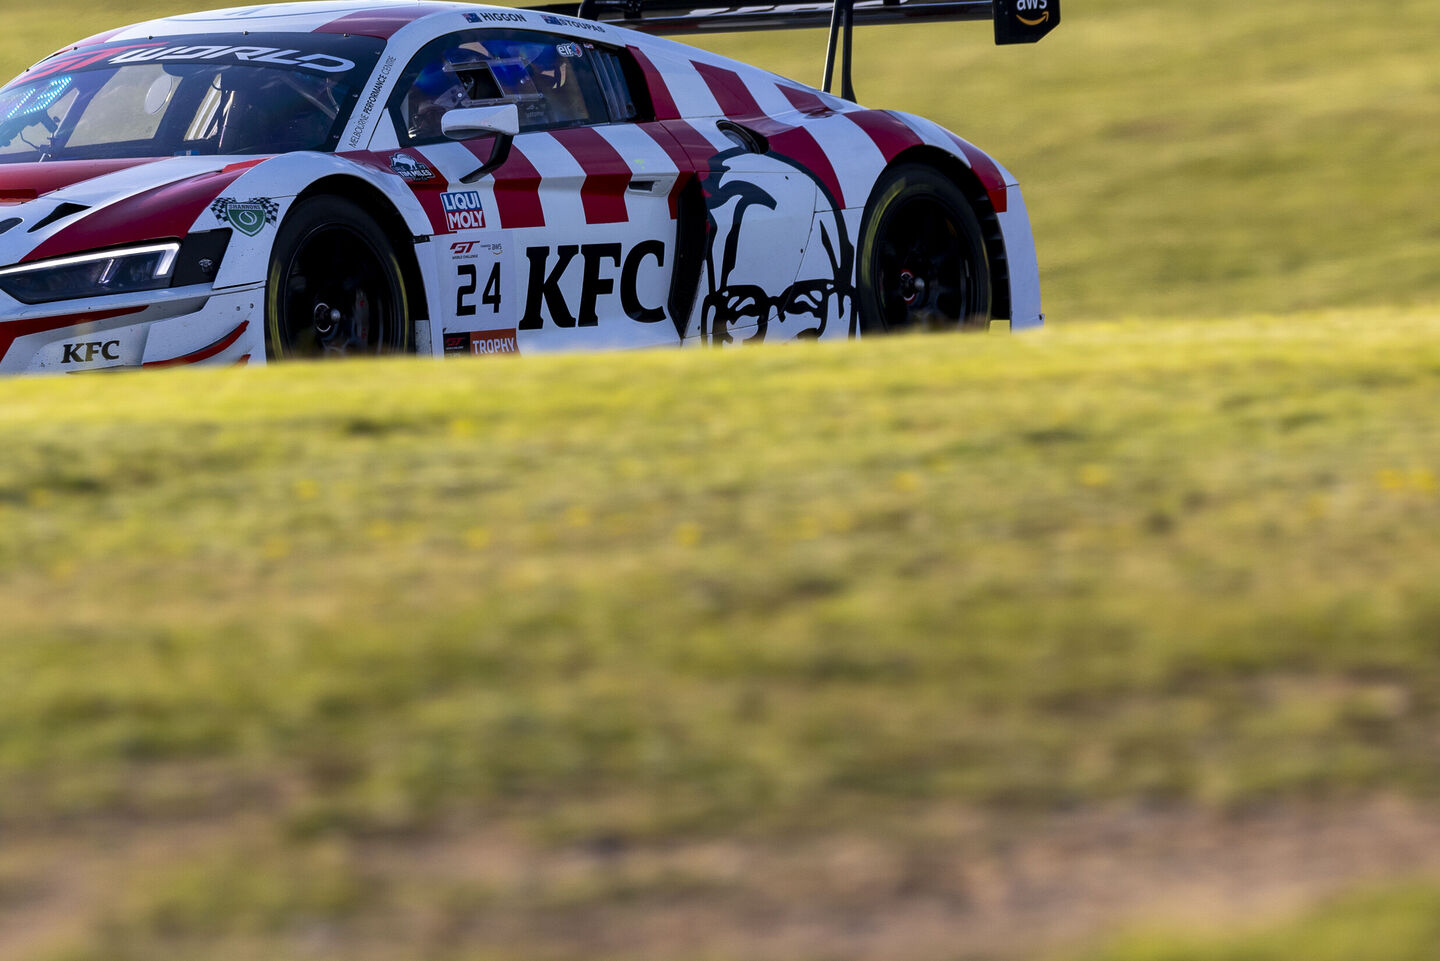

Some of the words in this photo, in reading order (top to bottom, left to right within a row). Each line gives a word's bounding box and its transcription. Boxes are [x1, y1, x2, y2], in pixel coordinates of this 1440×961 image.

[479, 12, 527, 23] HIGGON
[559, 18, 606, 33] STOUPAS
[108, 45, 356, 73] WORLD
[348, 114, 369, 148] MELBOURNE
[363, 73, 387, 114] PERFORMANCE
[381, 55, 397, 75] CENTRE
[443, 192, 481, 210] LIQUI
[447, 211, 483, 229] MOLY
[450, 241, 480, 254] GT
[456, 262, 502, 317] 24
[518, 239, 667, 331] KFC
[60, 340, 120, 363] KFC
[472, 337, 515, 355] TROPHY
